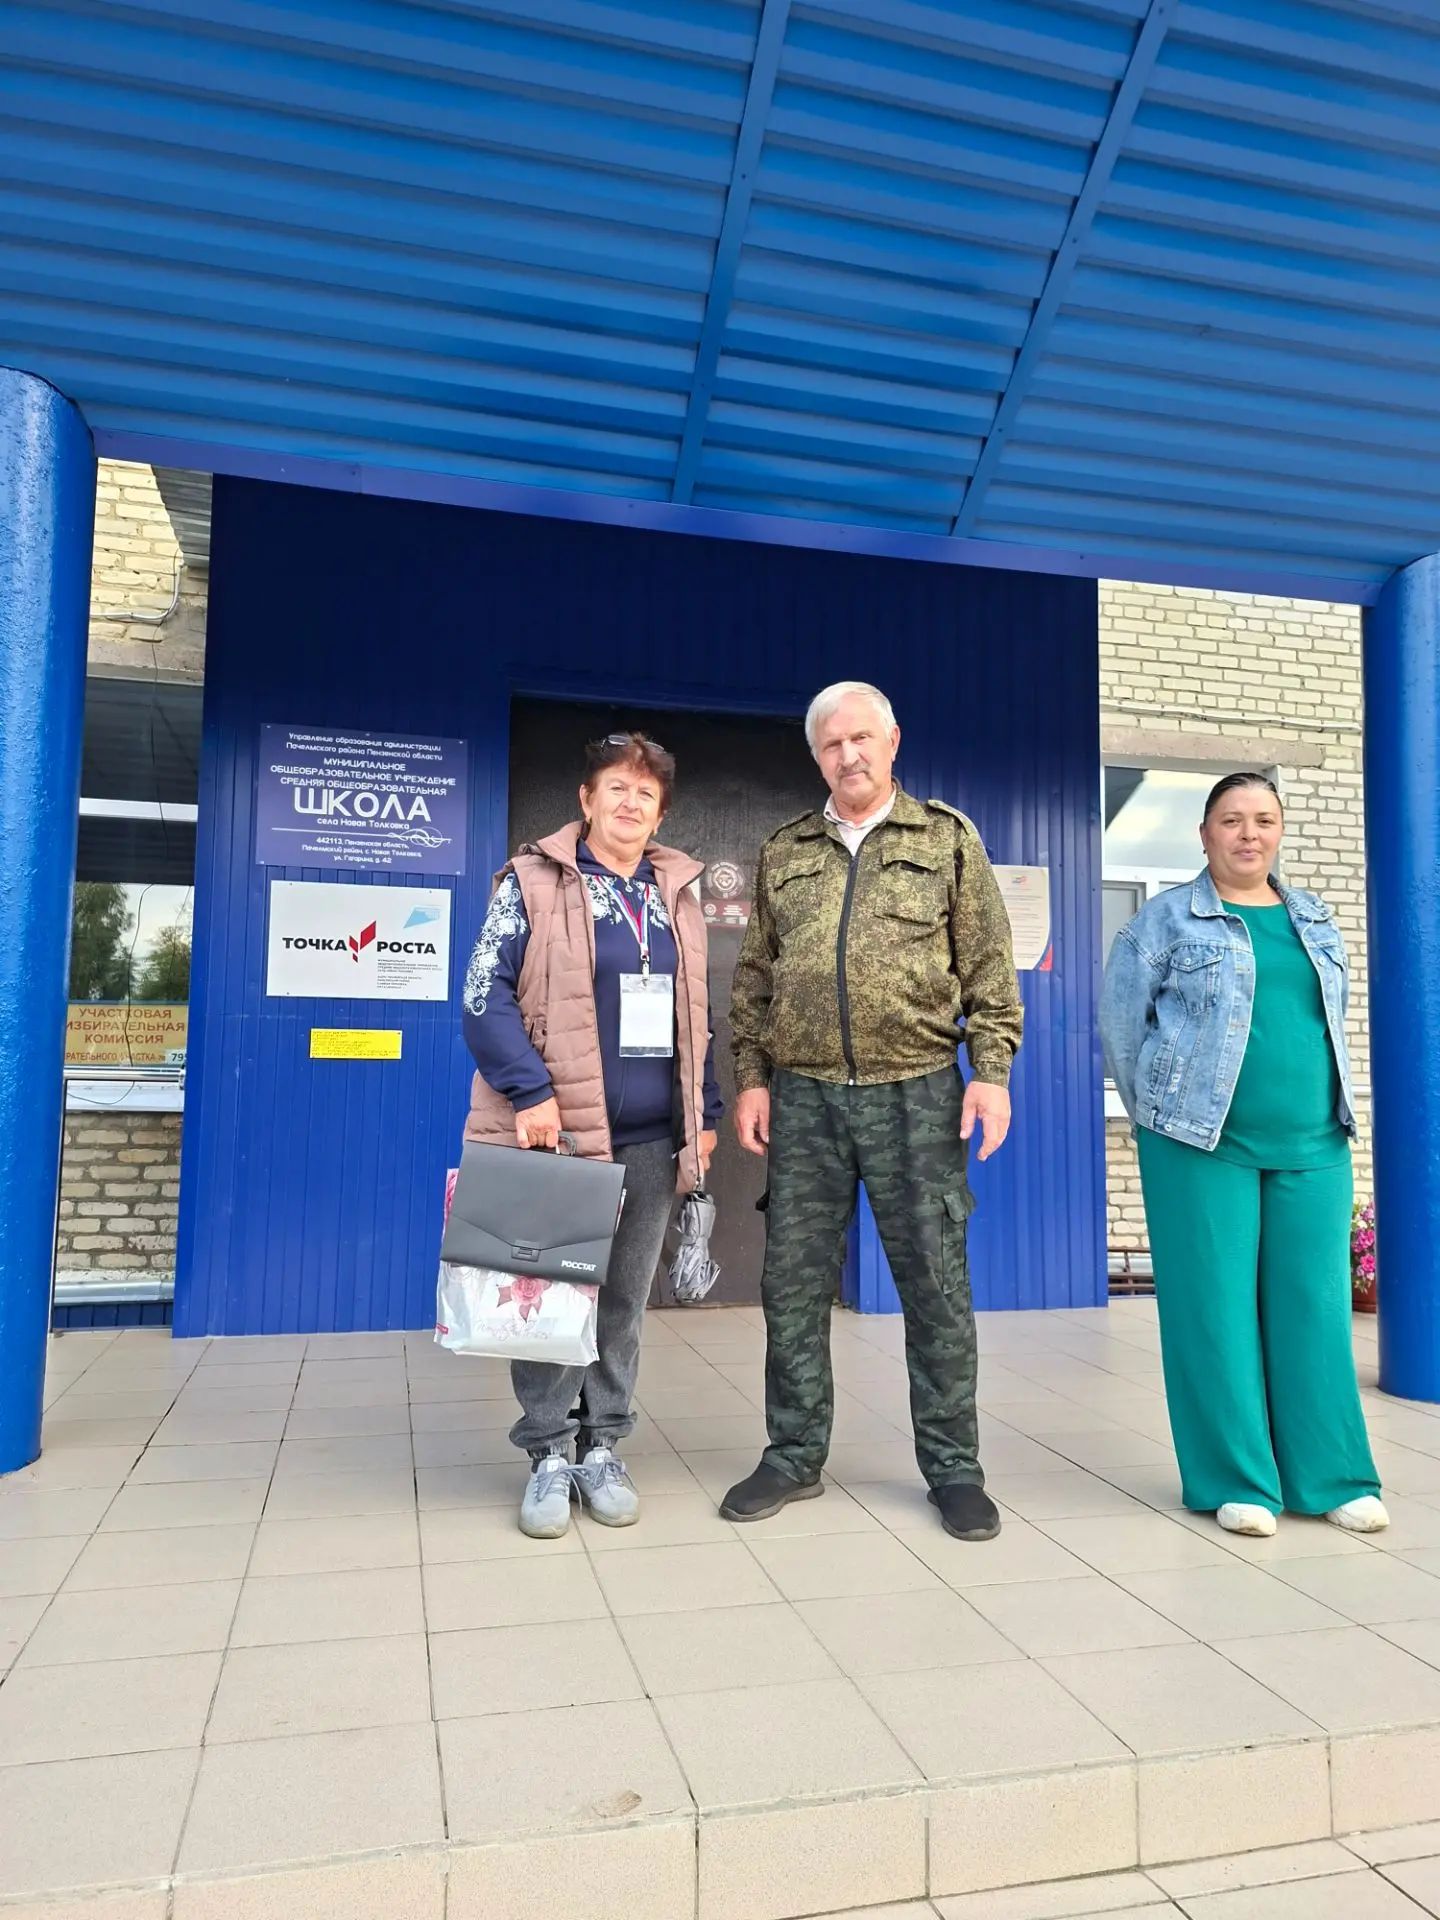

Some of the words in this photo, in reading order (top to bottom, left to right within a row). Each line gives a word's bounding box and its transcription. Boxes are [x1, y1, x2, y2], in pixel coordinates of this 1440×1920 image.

[288, 732, 334, 743] Управление
[335, 736, 382, 747] образования
[384, 741, 442, 752] администрации
[286, 741, 337, 752] Почелмского
[338, 746, 365, 755] района
[366, 748, 411, 759] Пензенской
[412, 752, 443, 761] области
[323, 757, 406, 771] МУНИЦИПАЛЬНОЕ
[270, 765, 392, 781] ОБЩЕОБРАЗОВАТЕЛЬНОЕ
[394, 774, 456, 786] УЧРЕЖДЕНИЕ
[280, 777, 325, 787] СРЕДНЯЯ
[327, 780, 447, 796] ОБЩЕОБРАЗОВАТЕЛЬНАЯ
[294, 787, 431, 822] ШКОЛА
[317, 817, 339, 826] села
[340, 818, 367, 828] Новая
[369, 819, 410, 830] Толковка
[282, 937, 347, 952] ТОЧКА
[376, 941, 437, 955] РОСТА
[79, 1007, 172, 1019] УЧАСТКОВАЯ
[66, 1020, 185, 1032] ИЗБИРАТЕЛЬНАЯ
[84, 1034, 164, 1044] КОМИССИЯ
[561, 1260, 597, 1272] РОССТАТ
